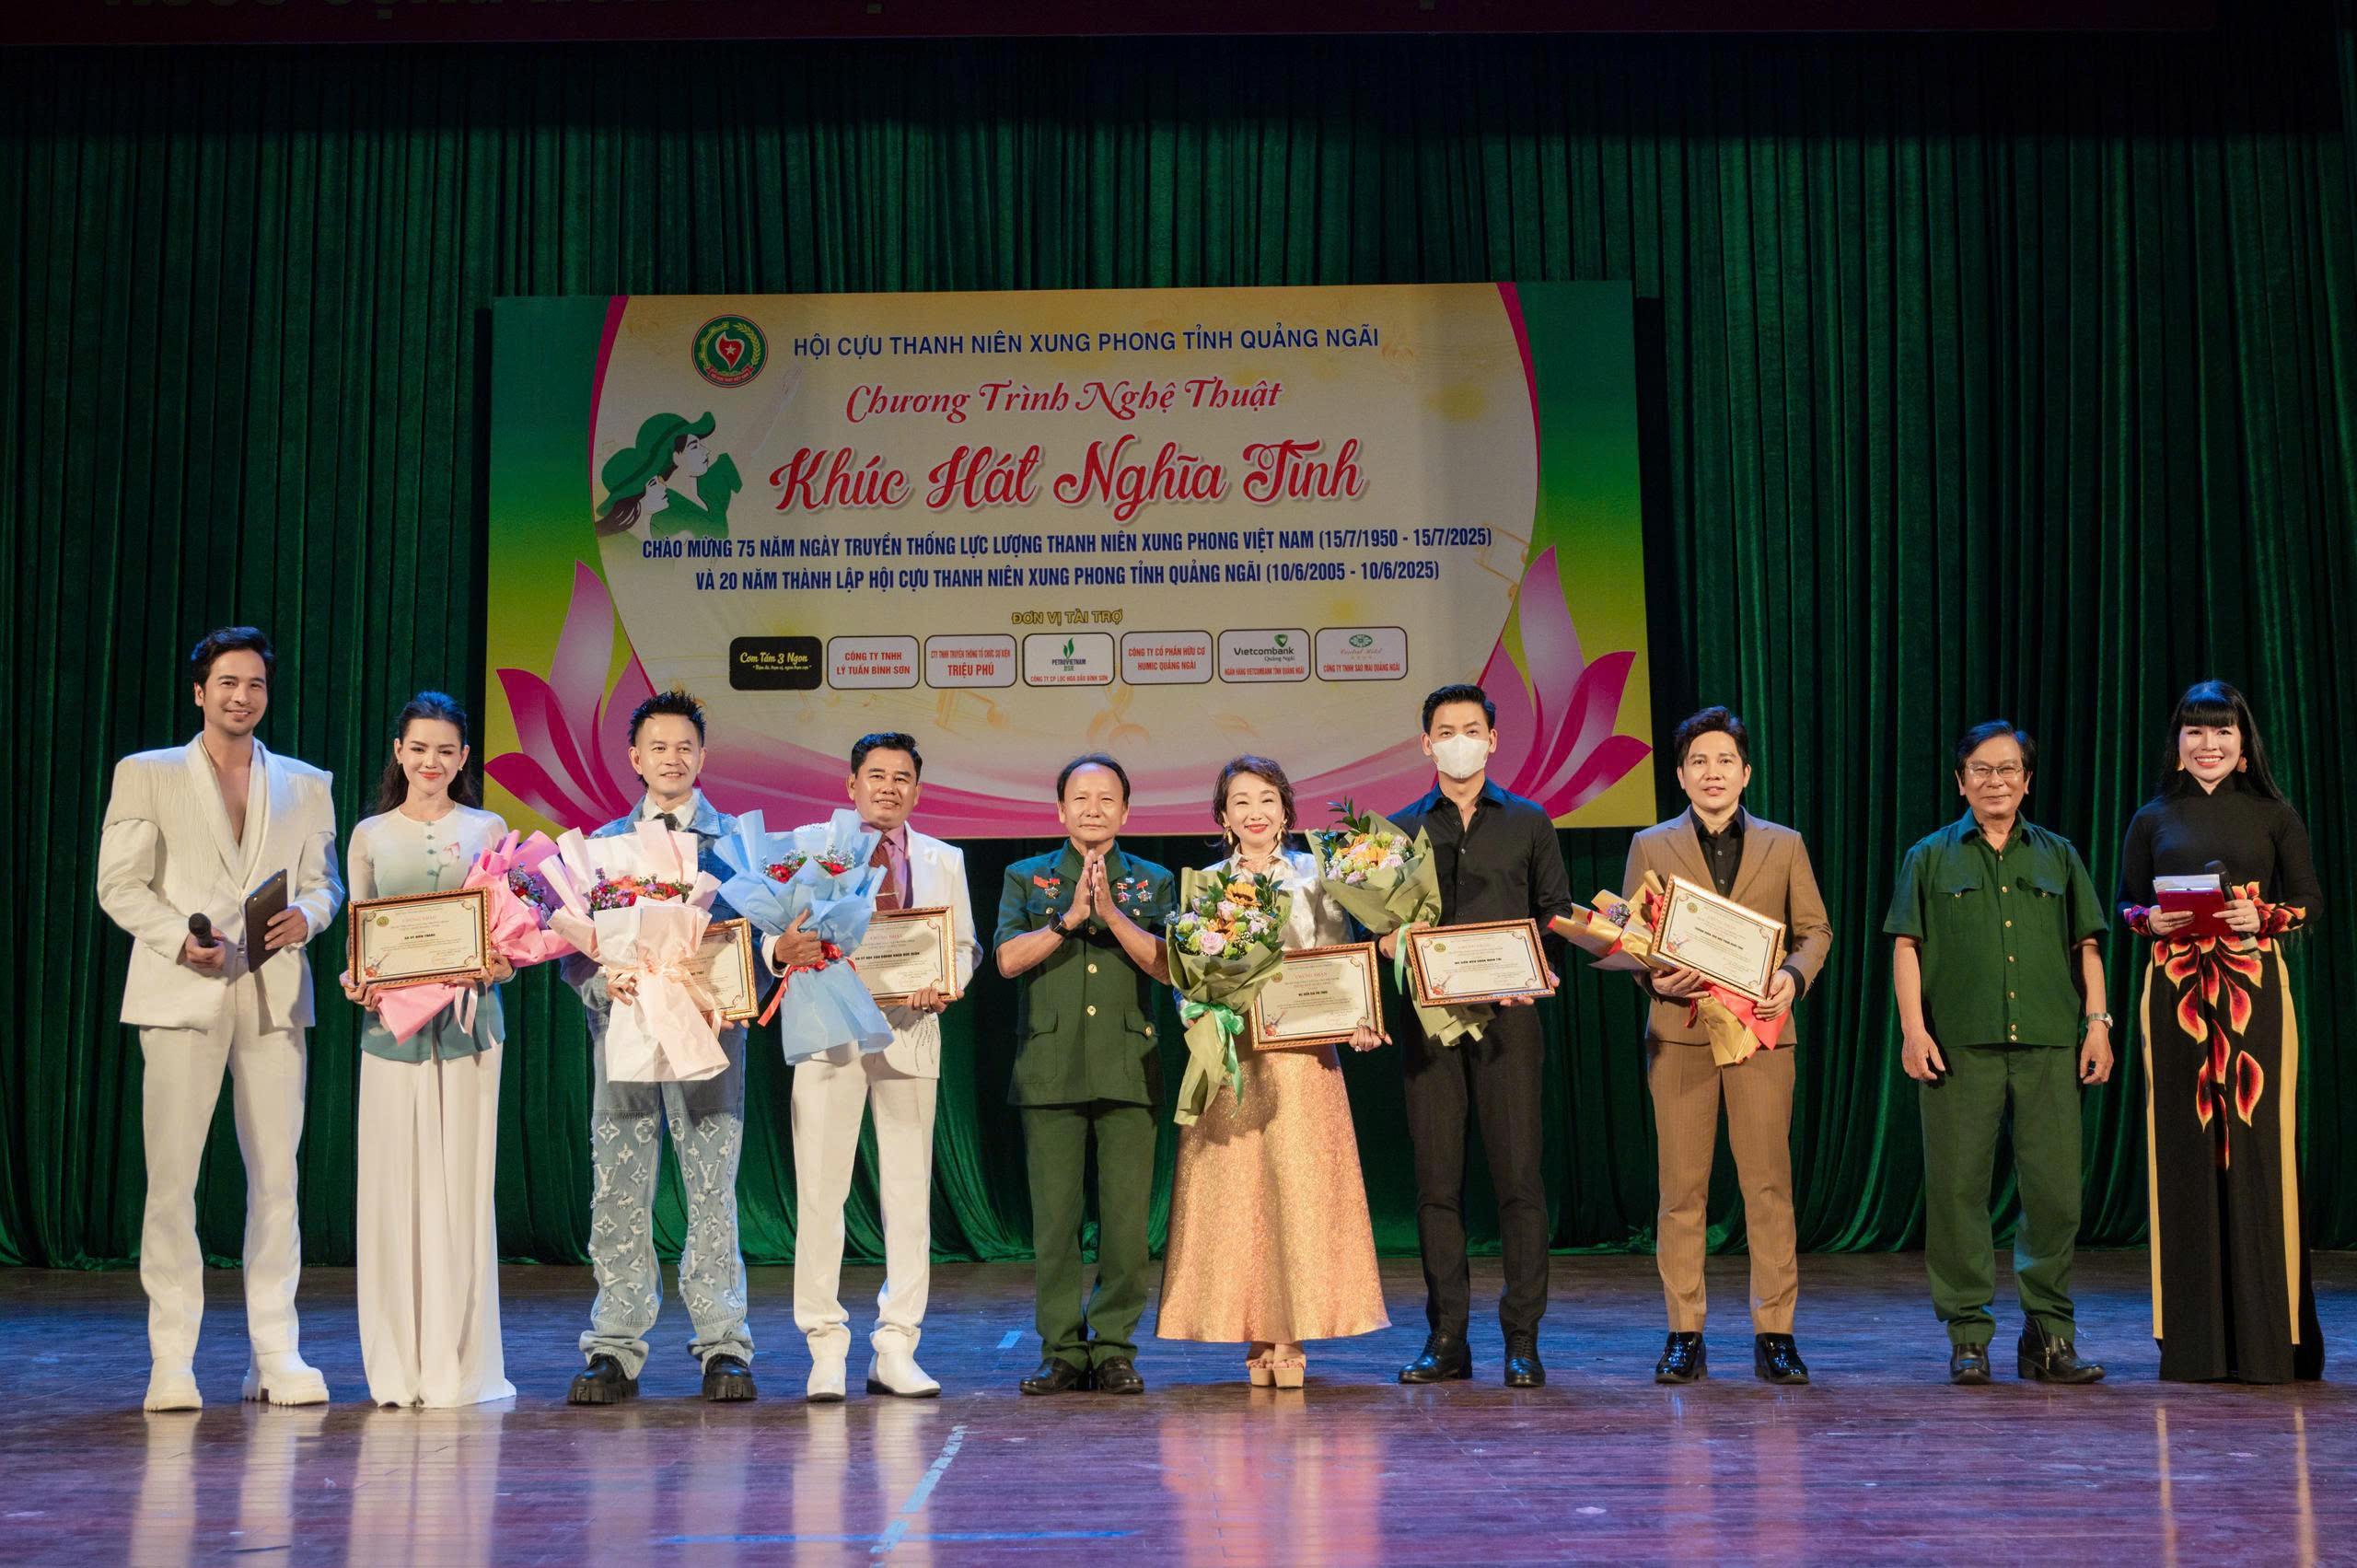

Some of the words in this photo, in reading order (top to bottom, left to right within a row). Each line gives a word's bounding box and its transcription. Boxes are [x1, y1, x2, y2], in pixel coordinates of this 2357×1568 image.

[794, 333, 830, 360] HỘI
[838, 333, 882, 360] CỰU
[890, 335, 963, 354] THANH
[971, 330, 1021, 354] NIÊN
[1030, 333, 1090, 352] XUNG
[1098, 331, 1175, 351] PHONG
[1183, 324, 1232, 350] TỈNH
[1240, 321, 1318, 349] QUẢNG
[1326, 324, 1378, 348] NGÃI
[846, 385, 970, 424] Chương
[979, 379, 1068, 412] Trình
[1075, 380, 1176, 421] Nghệ
[1185, 377, 1282, 412] Thuật
[769, 447, 909, 510] Khúc
[926, 445, 1044, 508] Hát
[1053, 434, 1231, 522] Nghĩa
[1242, 437, 1364, 505] Tình
[643, 536, 682, 558] CHÀO
[688, 536, 732, 558] MỪNG
[737, 540, 754, 557] 75
[760, 536, 796, 557] NĂM
[800, 534, 840, 557] NGÀY
[843, 531, 901, 555] TRUYỀN
[907, 530, 955, 554] THỐNG
[960, 535, 988, 558] LỰC
[993, 535, 1041, 558] LƯỢNG
[1047, 535, 1096, 552] THANH
[1101, 530, 1136, 552] NIÊN
[1142, 533, 1182, 551] XUNG
[1188, 531, 1238, 550] PHONG
[1243, 528, 1274, 552] VIỆT
[1279, 530, 1313, 549] NAM
[1319, 529, 1398, 550] (15/7/1950
[1413, 528, 1492, 546] 15/7/2025)
[696, 568, 714, 589] VÀ
[720, 573, 737, 589] 20
[743, 568, 777, 589] NĂM
[783, 568, 830, 589] THÀNH
[837, 567, 864, 592] LẬP
[869, 566, 893, 592] HỘI
[900, 568, 928, 591] CỰU
[934, 569, 982, 587] THANH
[988, 565, 1023, 587] NIÊN
[1029, 567, 1069, 586] XUNG
[1075, 566, 1125, 585] PHONG
[1130, 560, 1164, 584] TỈNH
[1169, 560, 1219, 585] QUẢNG
[1225, 561, 1260, 582] NGÃI
[1267, 562, 1345, 582] (10/6/2005
[1361, 561, 1439, 579] 10/6/2025)
[1012, 610, 1044, 624] ĐƠN
[1047, 611, 1062, 626] VỊ
[1064, 608, 1088, 623] TÀI
[1092, 609, 1123, 625] TRỢ
[778, 653, 785, 664] 3
[787, 652, 809, 665] Ngon
[845, 650, 867, 661] CÔNG
[881, 652, 902, 660] TNHH
[1128, 646, 1145, 656] CÔNG
[1234, 647, 1295, 656] Vietcombank
[893, 665, 911, 674] SƠN
[947, 662, 972, 678] TRIỆU
[976, 662, 994, 676] PHÚ
[1137, 662, 1157, 670] HUMIC
[1159, 659, 1179, 670] QUẢNG
